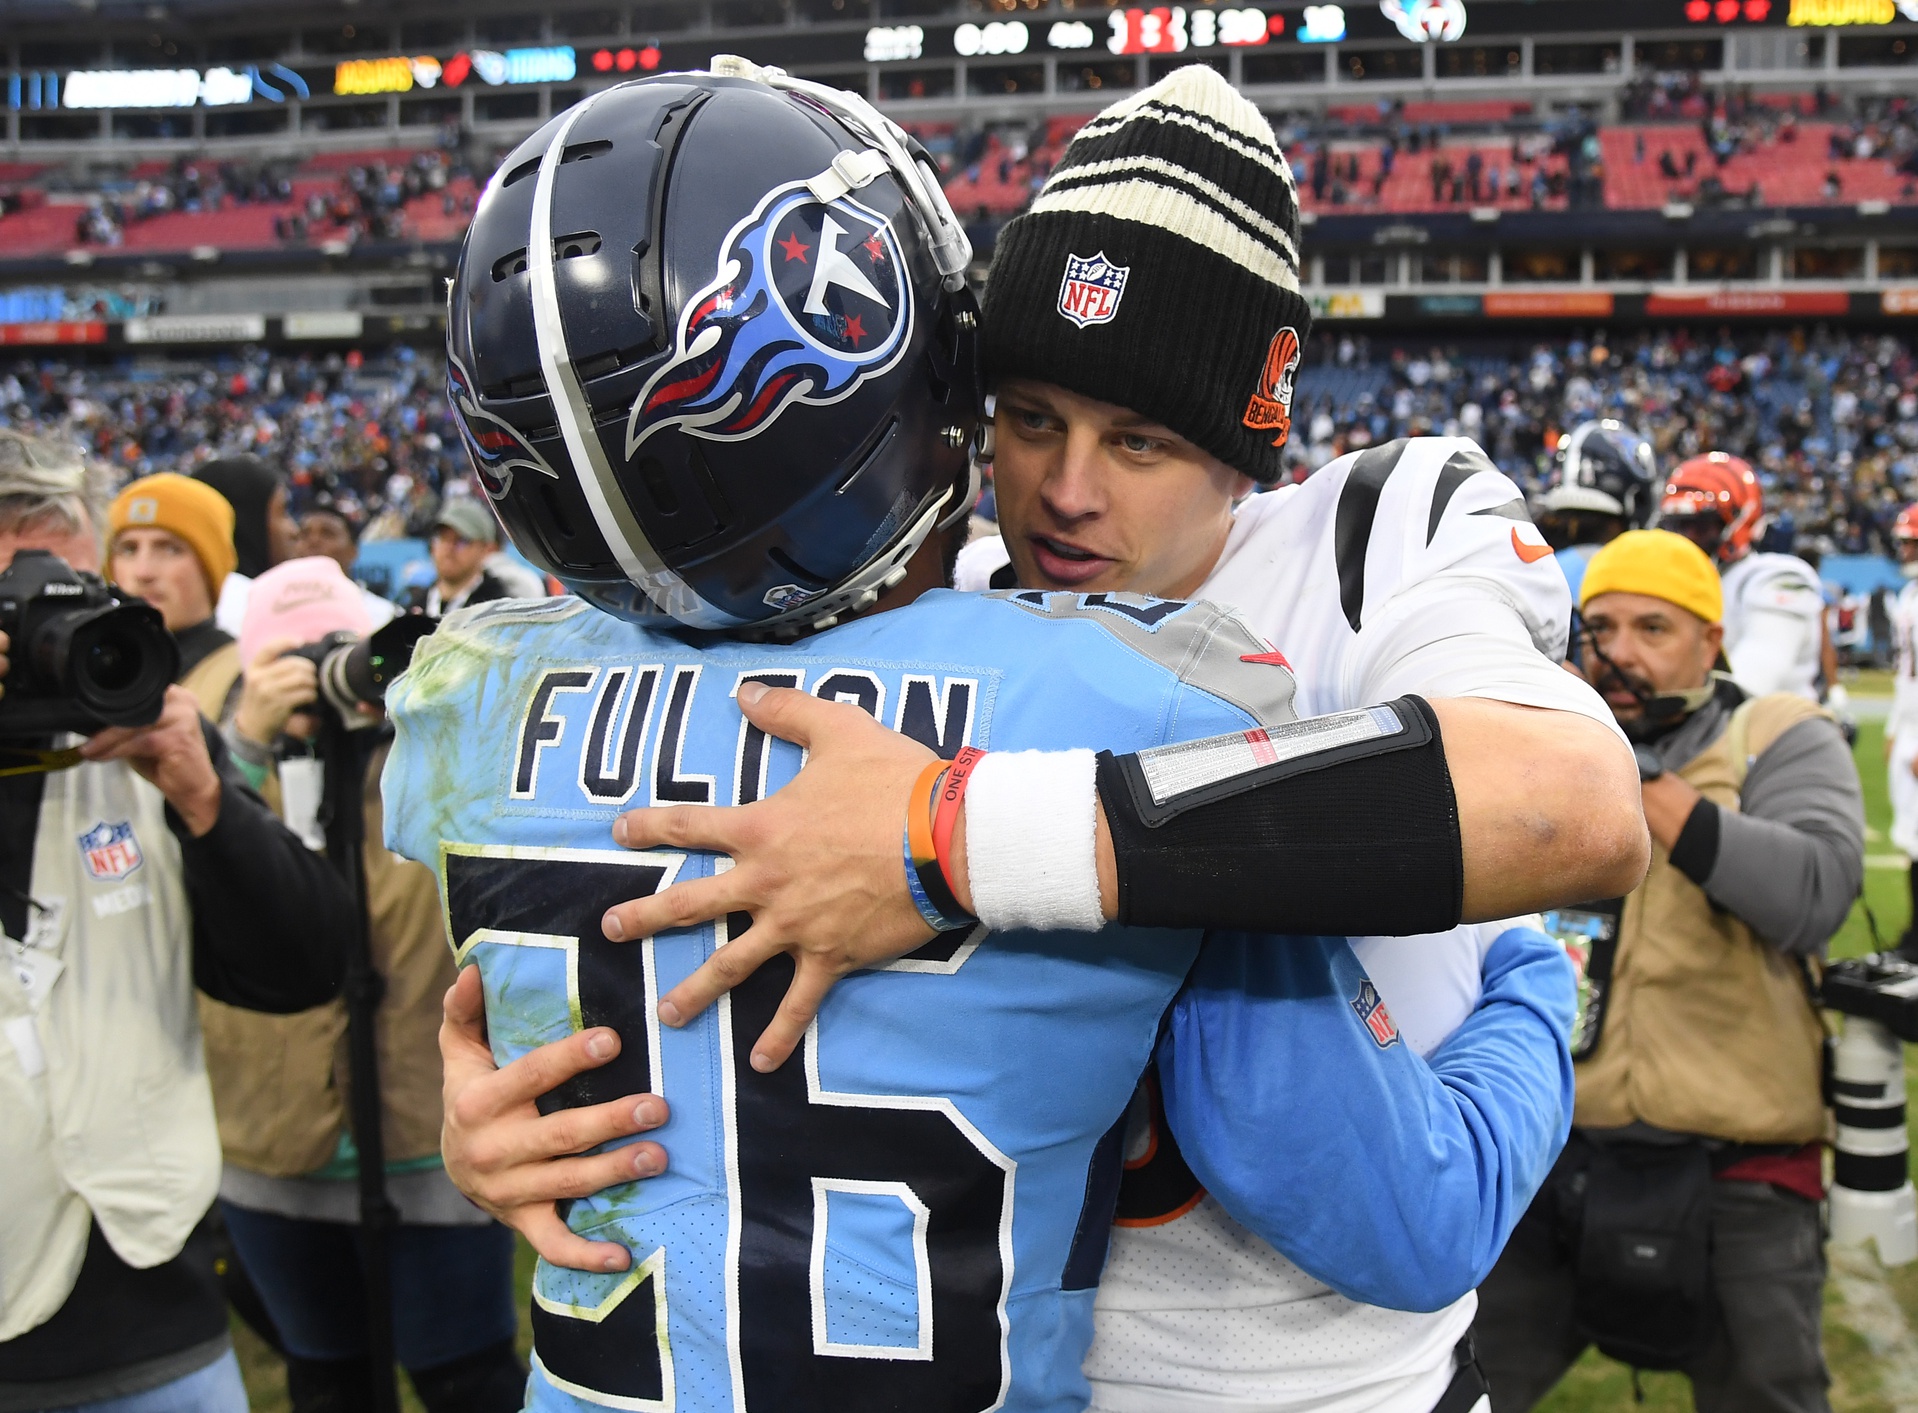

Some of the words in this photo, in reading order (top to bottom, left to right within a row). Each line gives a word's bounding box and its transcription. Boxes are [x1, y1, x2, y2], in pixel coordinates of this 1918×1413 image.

[1063, 282, 1110, 318] NFL
[945, 768, 967, 801] ONE
[90, 842, 138, 874] NFL
[1368, 1001, 1397, 1042] NF
